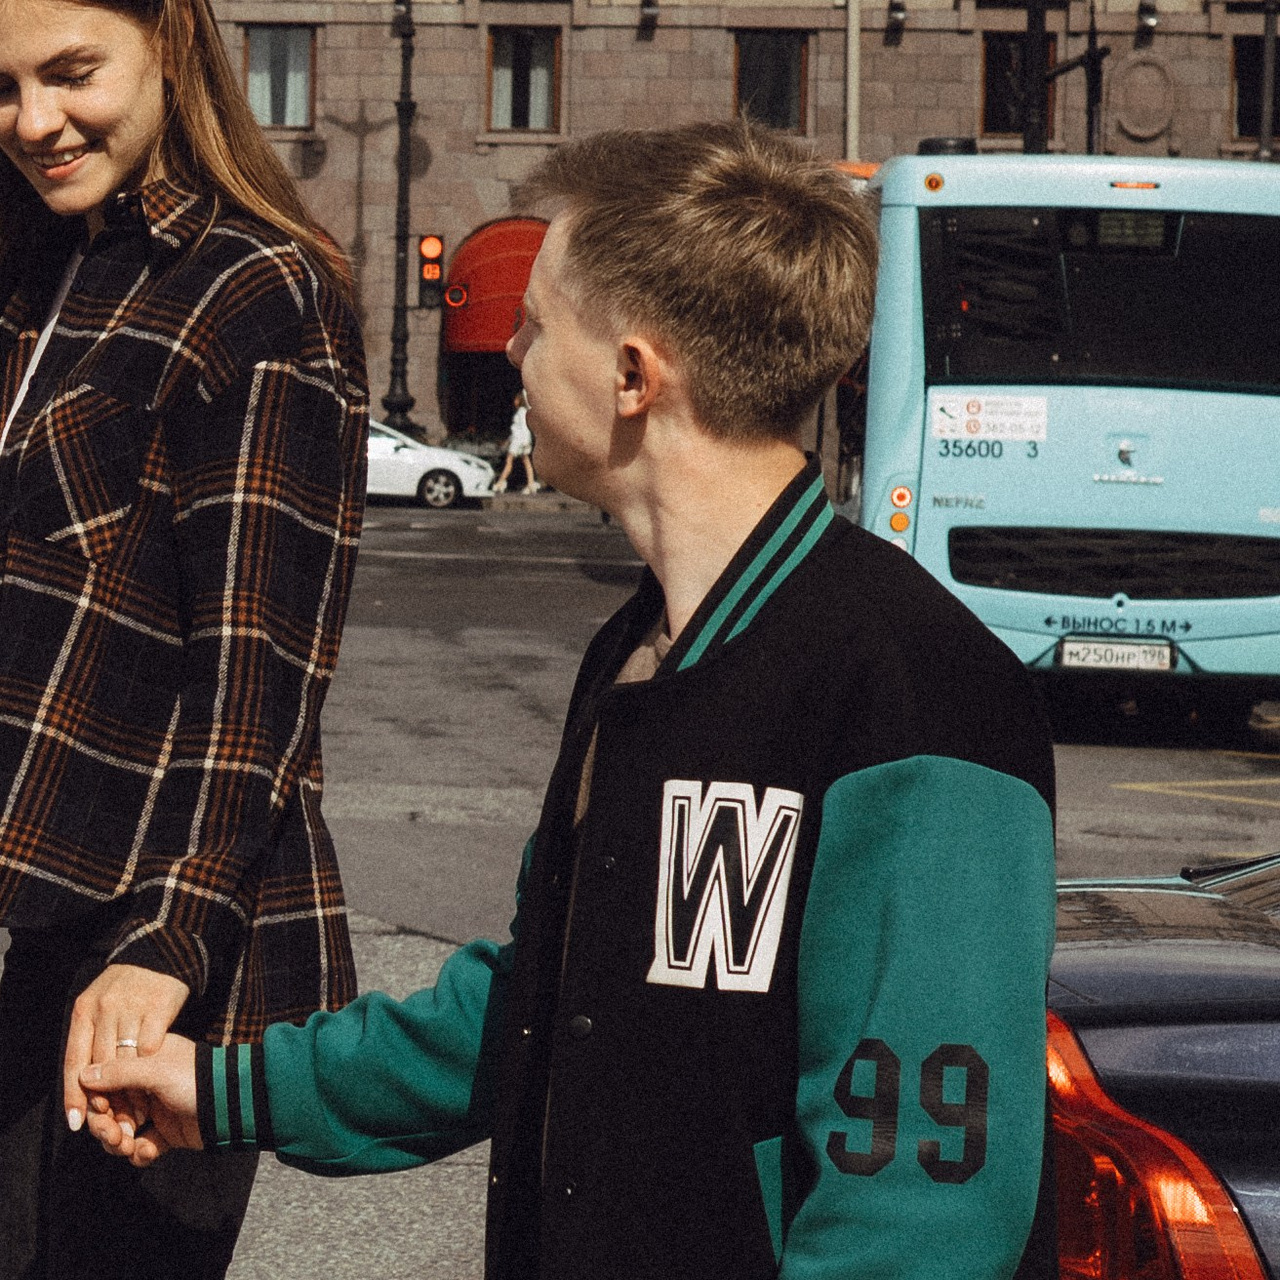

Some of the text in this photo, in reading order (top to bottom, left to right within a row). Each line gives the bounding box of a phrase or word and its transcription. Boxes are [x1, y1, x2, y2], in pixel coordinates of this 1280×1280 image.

[939, 440, 1039, 458] 35600 3
[1061, 616, 1127, 632] ВЫНОС
[1161, 619, 1176, 634] М
[646, 779, 803, 993] W
[825, 1038, 990, 1185] 99
